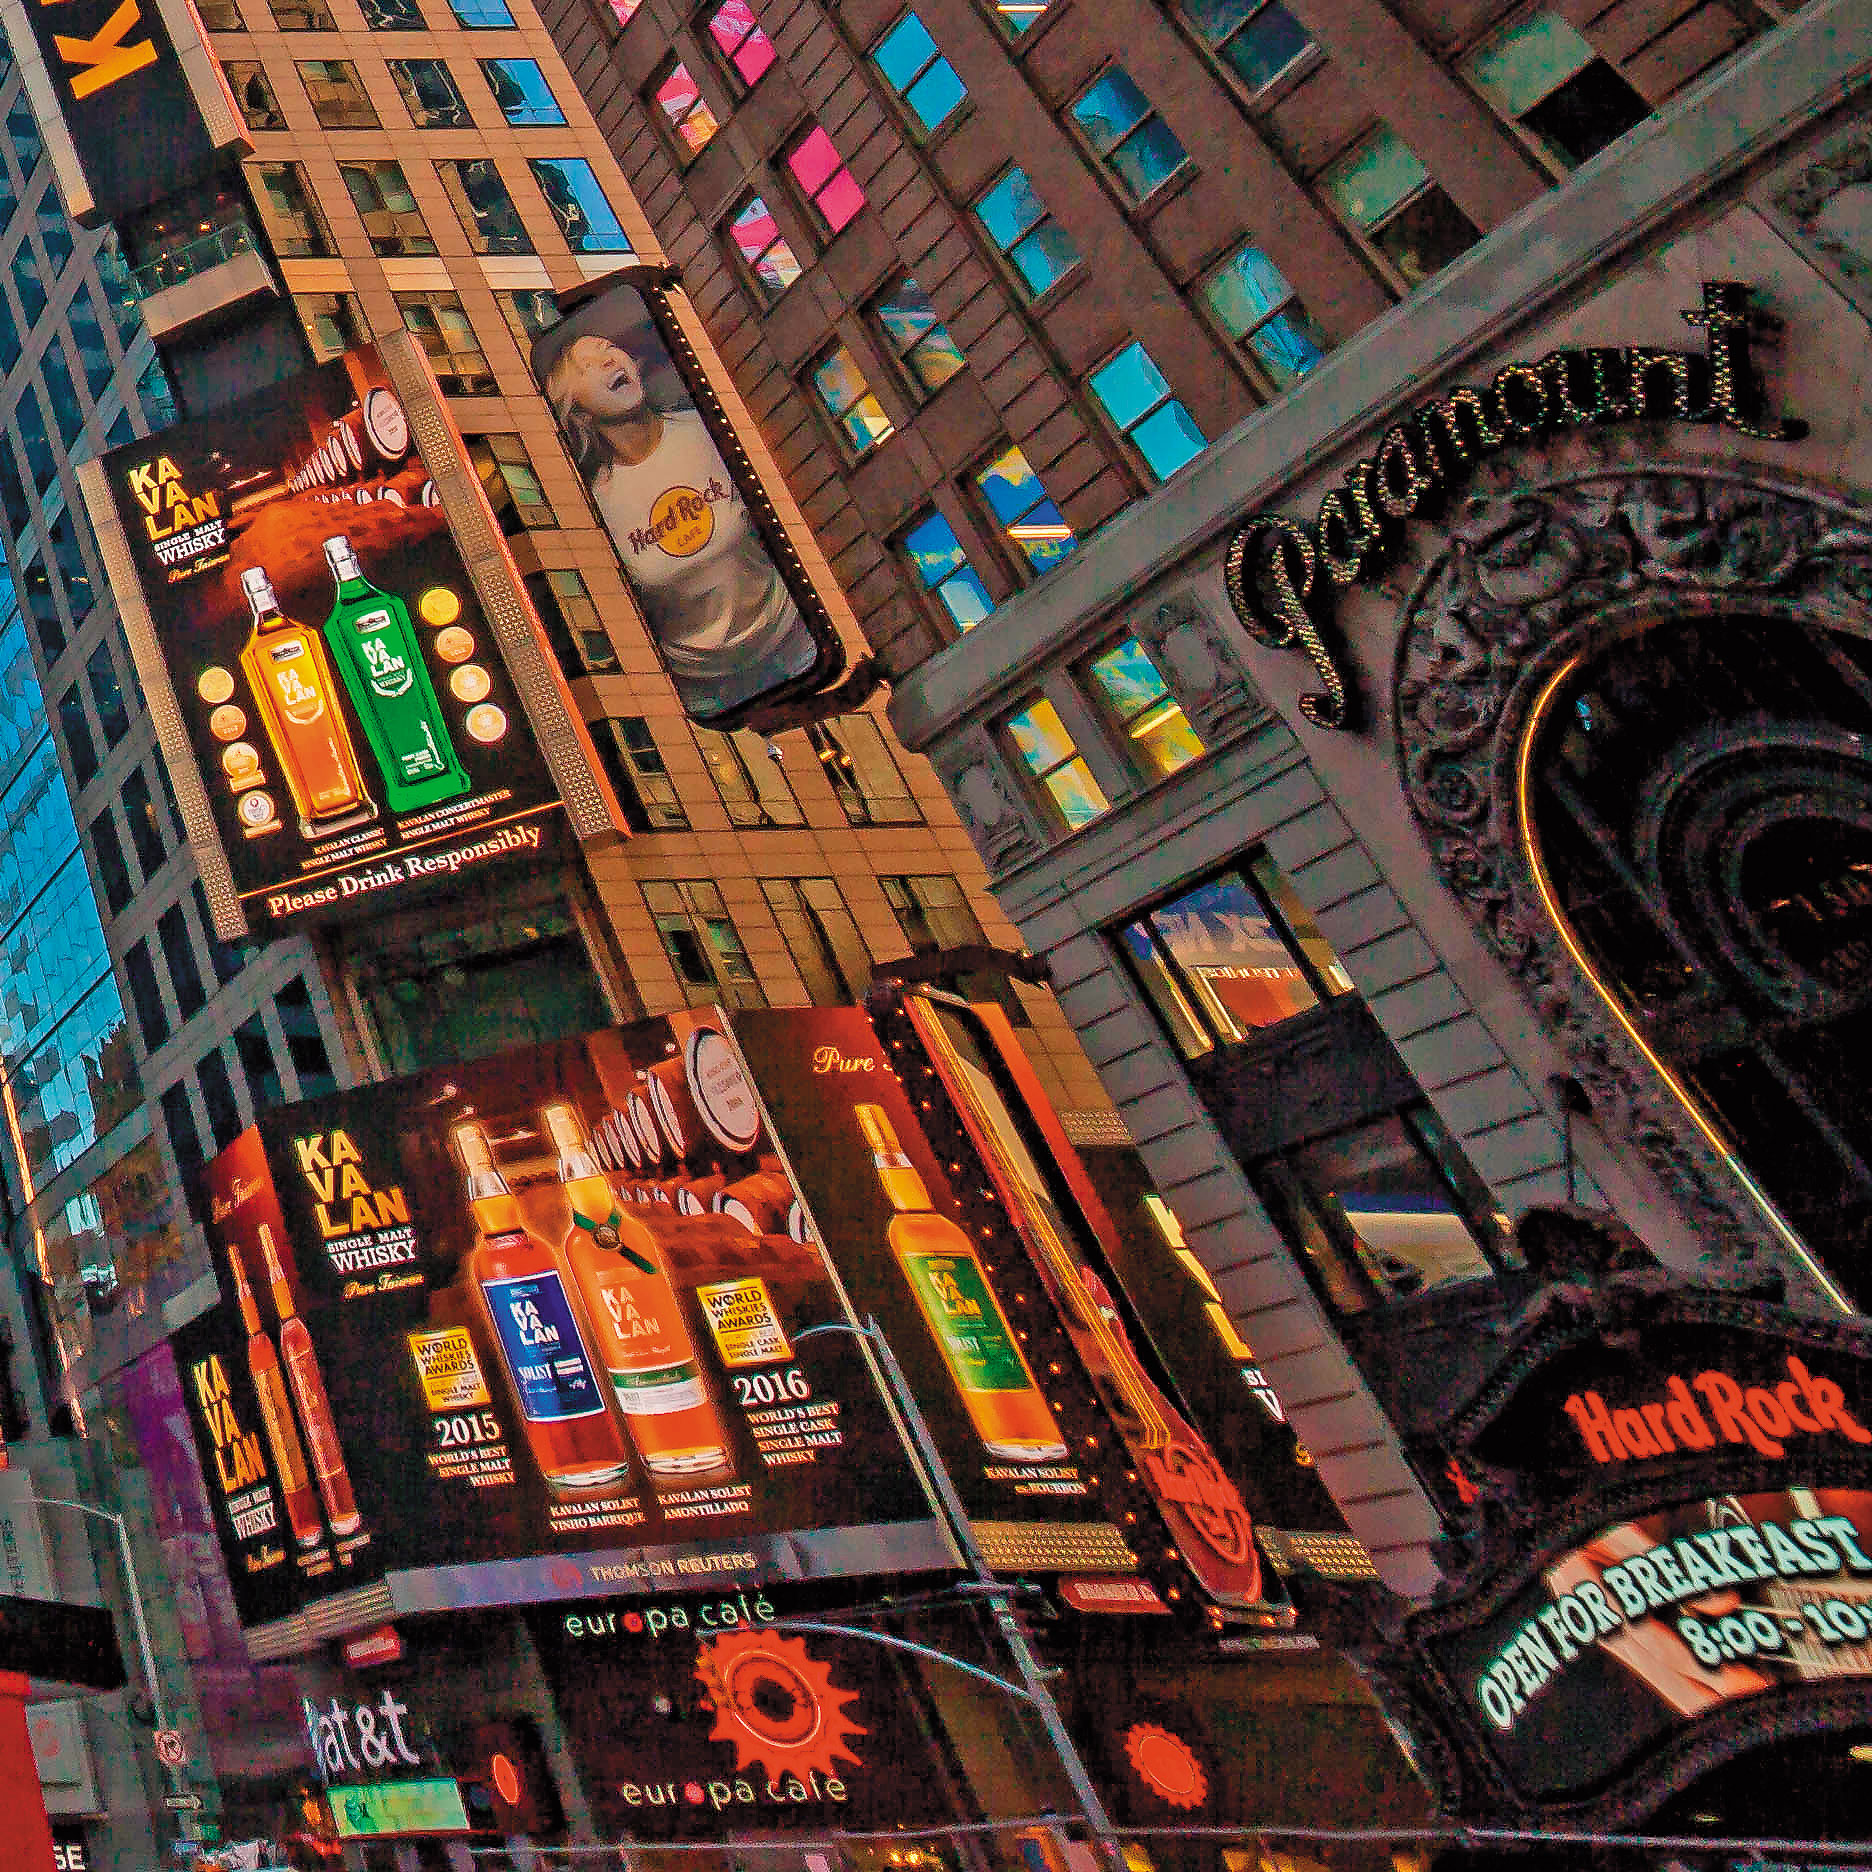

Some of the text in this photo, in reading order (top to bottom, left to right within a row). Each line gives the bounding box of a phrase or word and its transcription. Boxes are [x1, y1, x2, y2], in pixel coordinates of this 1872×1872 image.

[128, 457, 183, 494] KA
[137, 480, 190, 515] VA
[1224, 281, 1811, 728] Paramount
[144, 491, 221, 541] LAN
[627, 478, 731, 555] Hard Rock
[154, 532, 191, 552] SINGLE
[156, 528, 226, 566] WHISKY
[268, 824, 542, 919] Please Drink Responsibly
[813, 1045, 874, 1073] Pure
[295, 1129, 362, 1172] KA
[305, 1161, 373, 1203] VA
[314, 1185, 412, 1239] LAN
[326, 1227, 414, 1255] SINGLE MALT
[330, 1240, 417, 1274] WHISKY
[706, 1289, 763, 1308] WORLD
[717, 1312, 772, 1331] AWARDS
[417, 1337, 468, 1356] WORLD
[424, 1358, 475, 1377] AWARDS
[733, 1368, 811, 1407] 2016
[807, 1402, 841, 1418] BEST
[1564, 1354, 1872, 1463] Hard Rock
[434, 1412, 501, 1448] 2015
[752, 1418, 837, 1439] SINGLE CASK
[757, 1431, 844, 1452] SINGLE MALT
[214, 1430, 268, 1495] LAN
[479, 1458, 512, 1473] MALT
[762, 1450, 817, 1467] WHISKY
[550, 1501, 601, 1517] KAVALAN
[658, 1488, 710, 1506] KAVALAN
[664, 1501, 750, 1520] AMONTILLADO
[591, 1553, 757, 1581] THOMSON REUTERS
[566, 1605, 690, 1637] europa
[1475, 1516, 1872, 1730] OPEN FOR BREAKFAST
[1676, 1609, 1784, 1666] 8:00
[315, 1689, 420, 1773] at&t
[622, 1779, 755, 1811] europa
